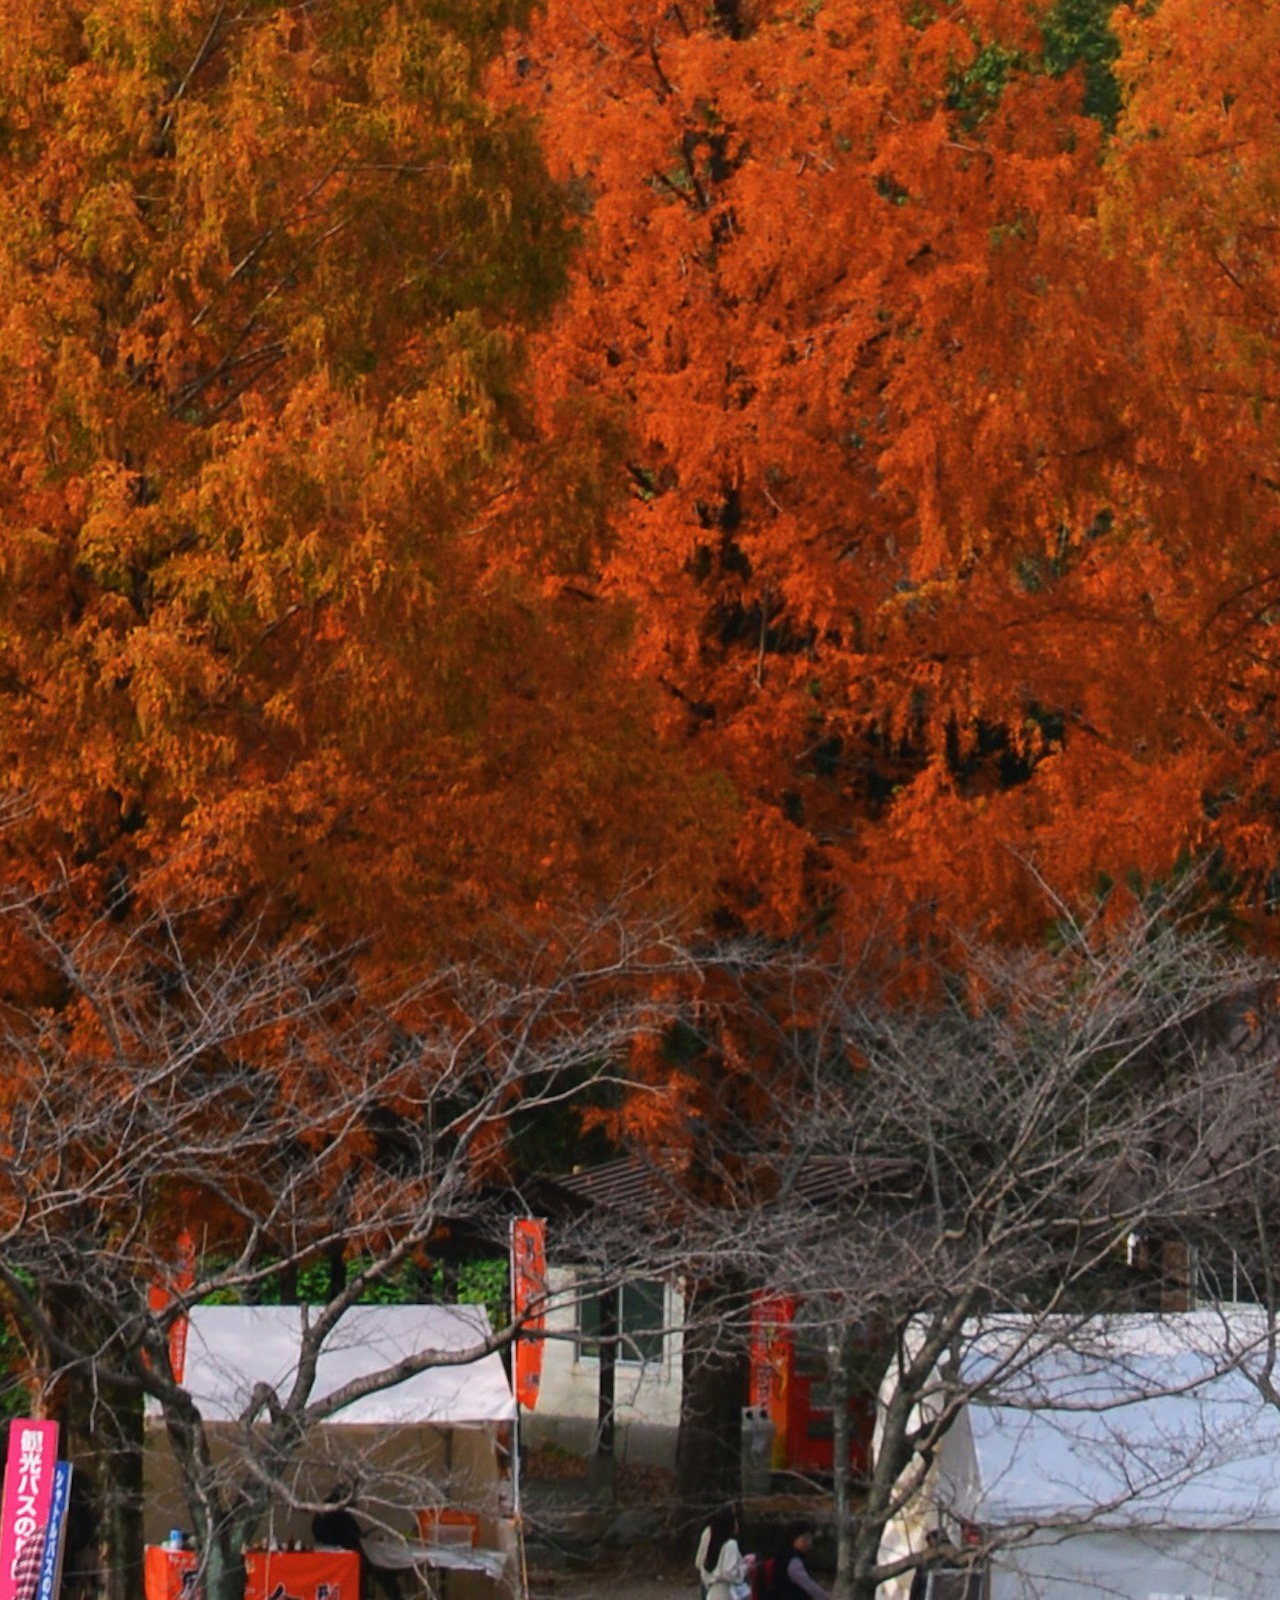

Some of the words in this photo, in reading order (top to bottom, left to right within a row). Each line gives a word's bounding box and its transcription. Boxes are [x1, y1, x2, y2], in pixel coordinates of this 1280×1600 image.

[11, 1429, 44, 1580] 観光バスの
[41, 1469, 65, 1600] シャトルバスの
